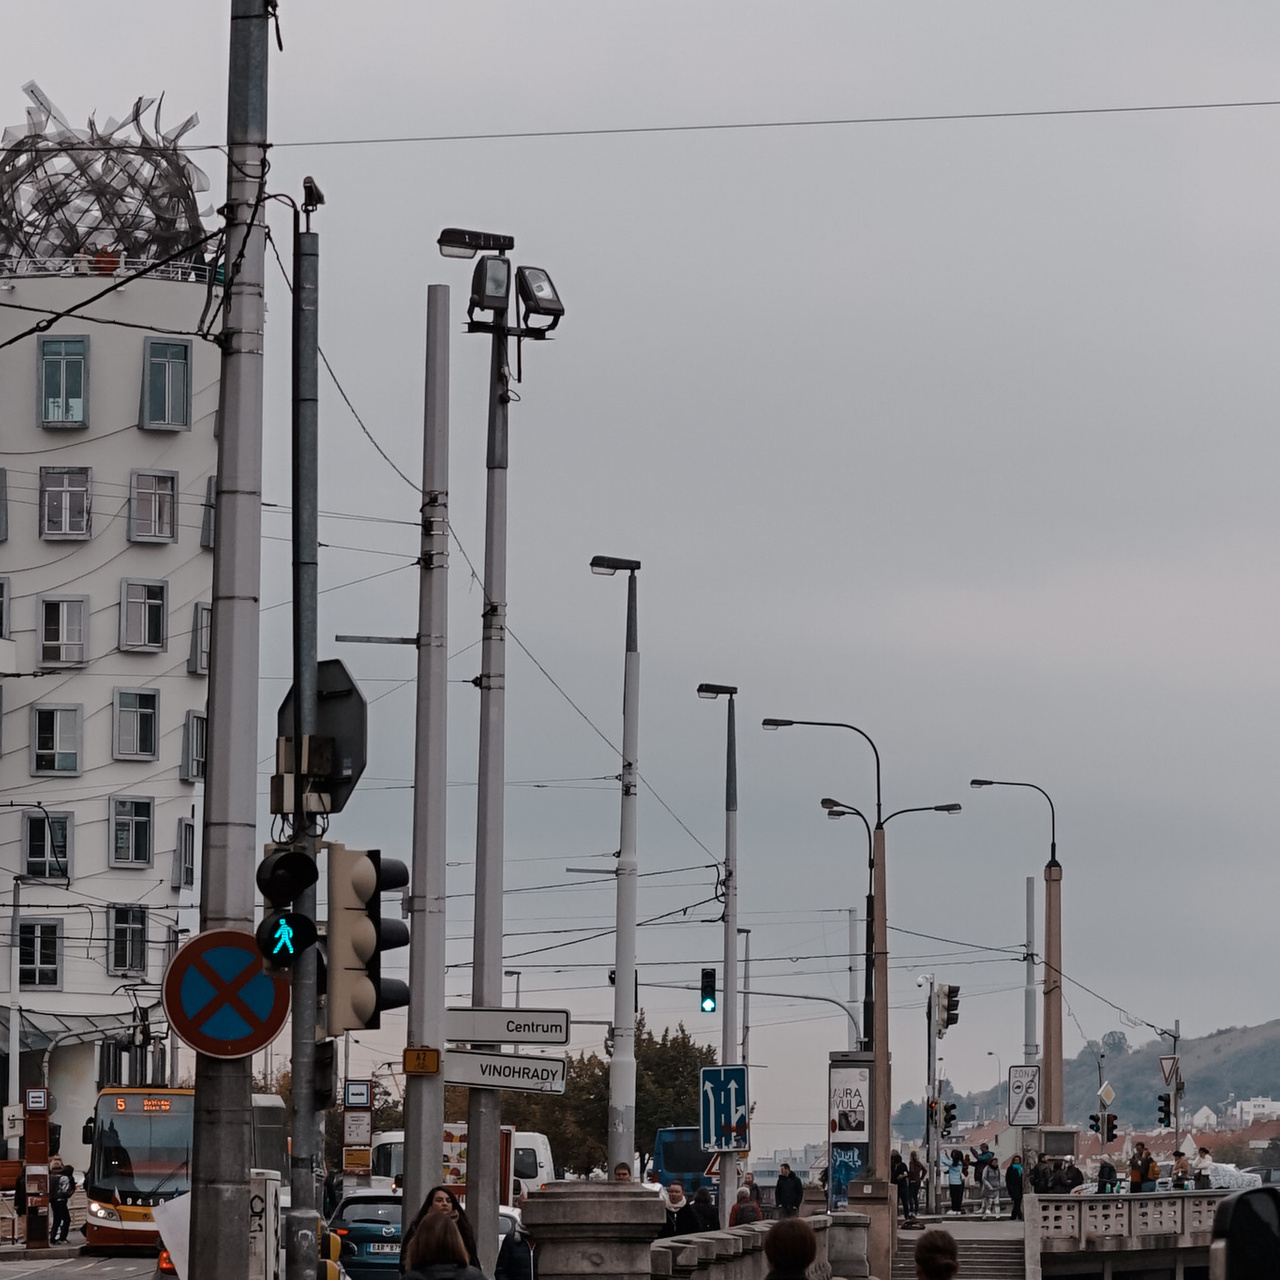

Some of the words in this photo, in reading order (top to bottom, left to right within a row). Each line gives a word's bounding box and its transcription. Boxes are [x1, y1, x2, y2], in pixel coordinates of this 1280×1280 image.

[506, 1020, 563, 1034] Centrum
[480, 1063, 558, 1082] VINOHRADY
[116, 1098, 126, 1111] 5
